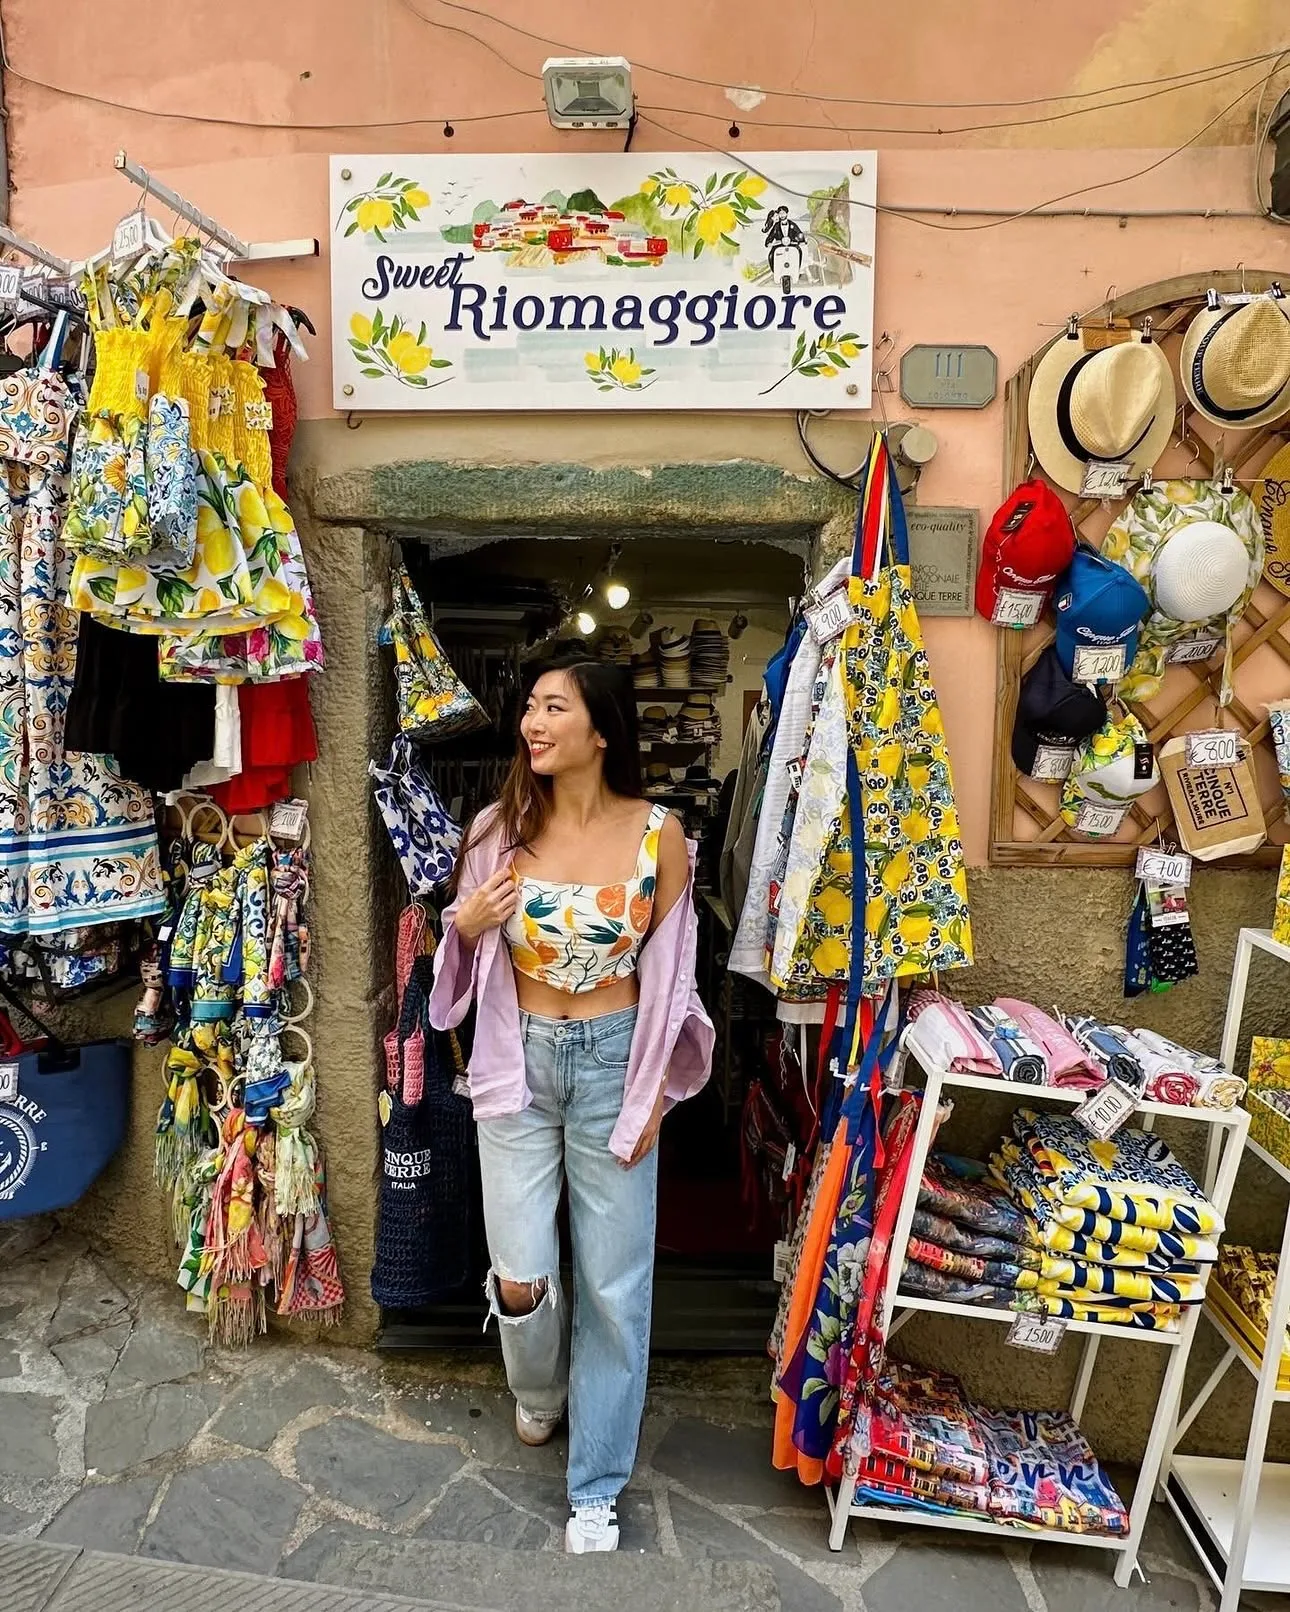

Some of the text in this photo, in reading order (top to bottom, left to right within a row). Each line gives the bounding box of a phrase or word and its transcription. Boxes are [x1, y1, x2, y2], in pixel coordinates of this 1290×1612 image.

[361, 252, 474, 300] Sweet
[444, 282, 848, 347] Riomaggiore
[938, 591, 963, 601] TERRE
[1193, 771, 1218, 819] TERRE
[391, 1181, 416, 1190] ITALIA
